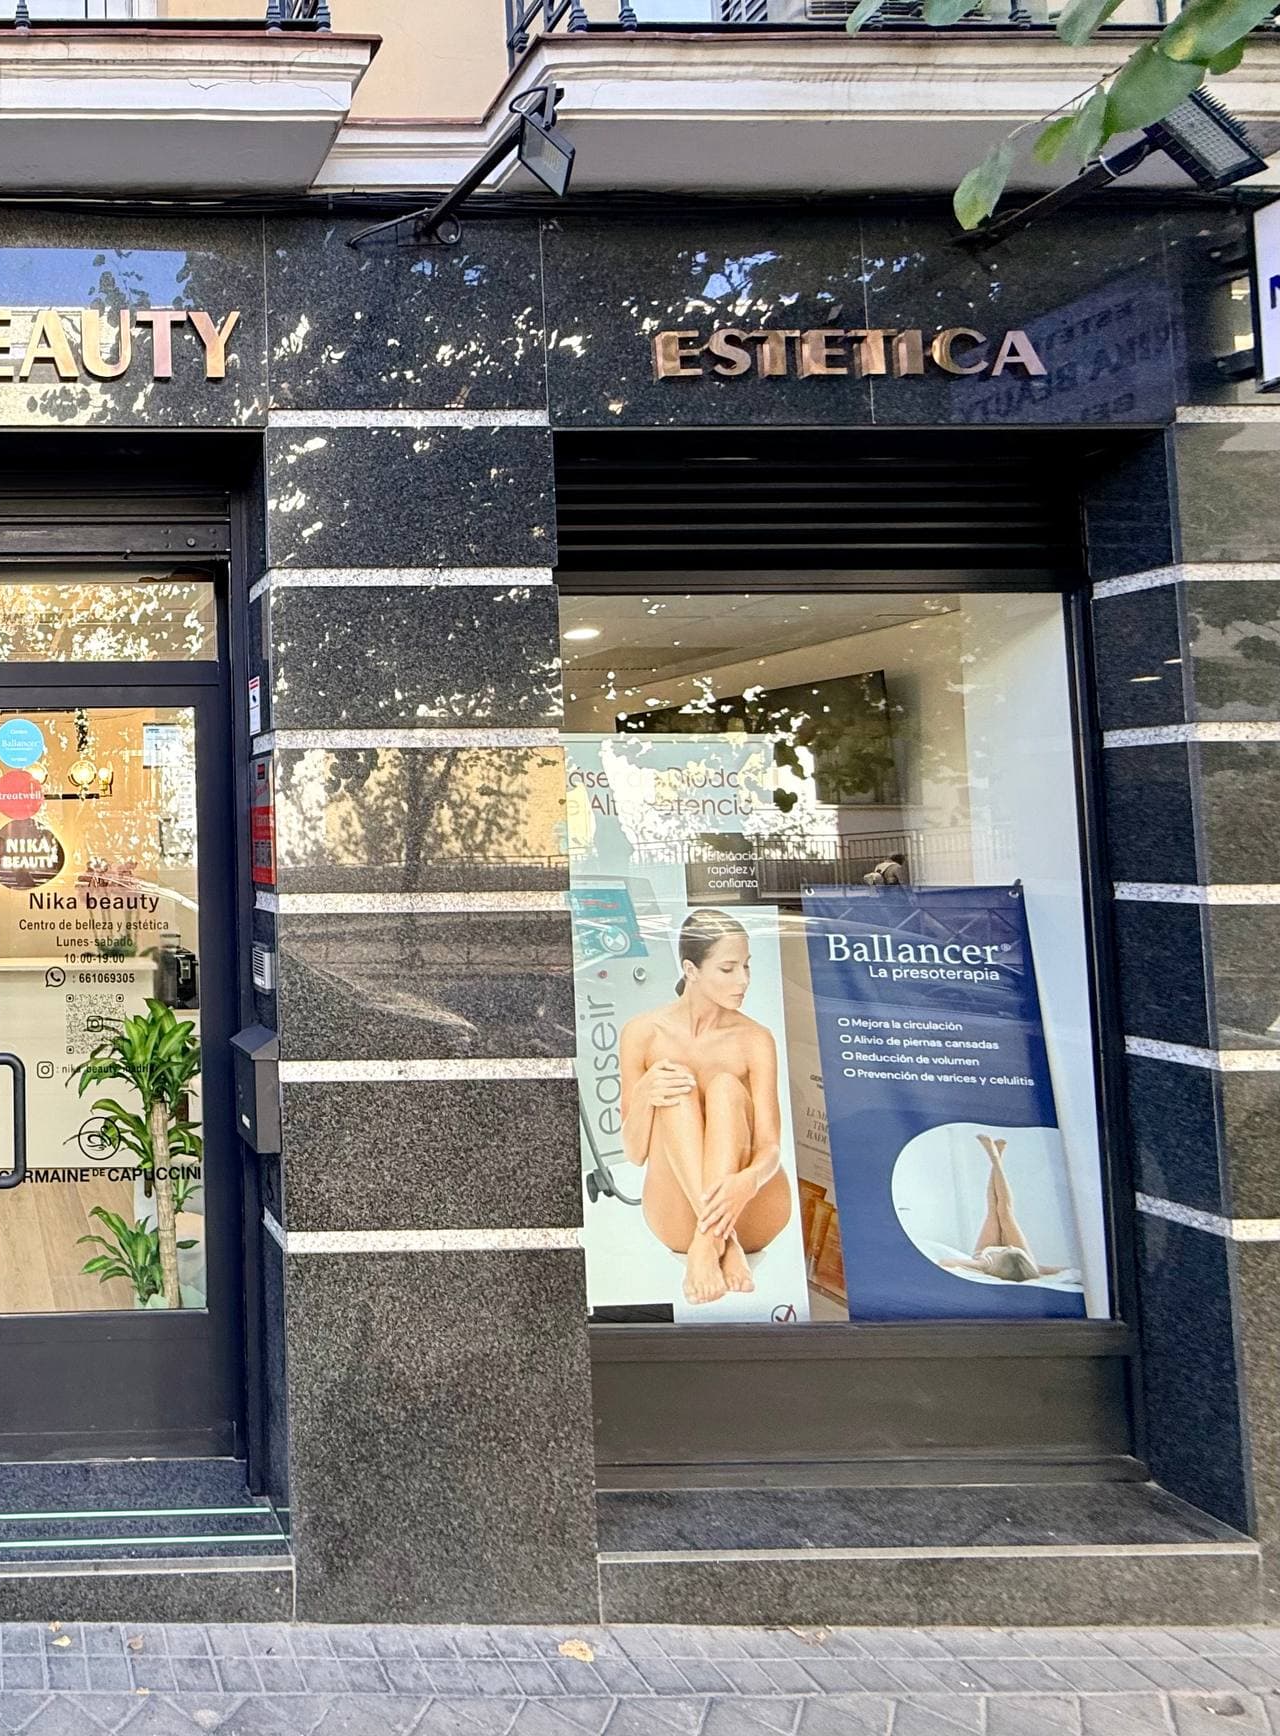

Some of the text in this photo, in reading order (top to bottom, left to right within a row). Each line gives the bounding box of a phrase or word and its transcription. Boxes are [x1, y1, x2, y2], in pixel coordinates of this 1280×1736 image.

[652, 304, 1048, 380] ESTÉTICA
[6, 838, 50, 853] NIKA
[1, 855, 56, 869] BEAUTY
[707, 864, 756, 877] rapidez y
[708, 877, 759, 888] confianza
[29, 892, 160, 913] Nika beauty
[19, 918, 169, 933] Centro de belleza y estética
[64, 953, 125, 964] 10:00-19:00
[79, 973, 135, 984] 661069305
[869, 965, 1000, 983] La presoterapia
[851, 1018, 963, 1031] Mejora la circulación
[853, 1035, 1000, 1050] Alivio de piernas cansadas
[855, 1051, 980, 1067] Reducción de volumen
[857, 1068, 1035, 1087] Prevención de varices y celulitis
[92, 1168, 105, 1177] DE
[108, 1166, 201, 1182] CAPUCCINI
